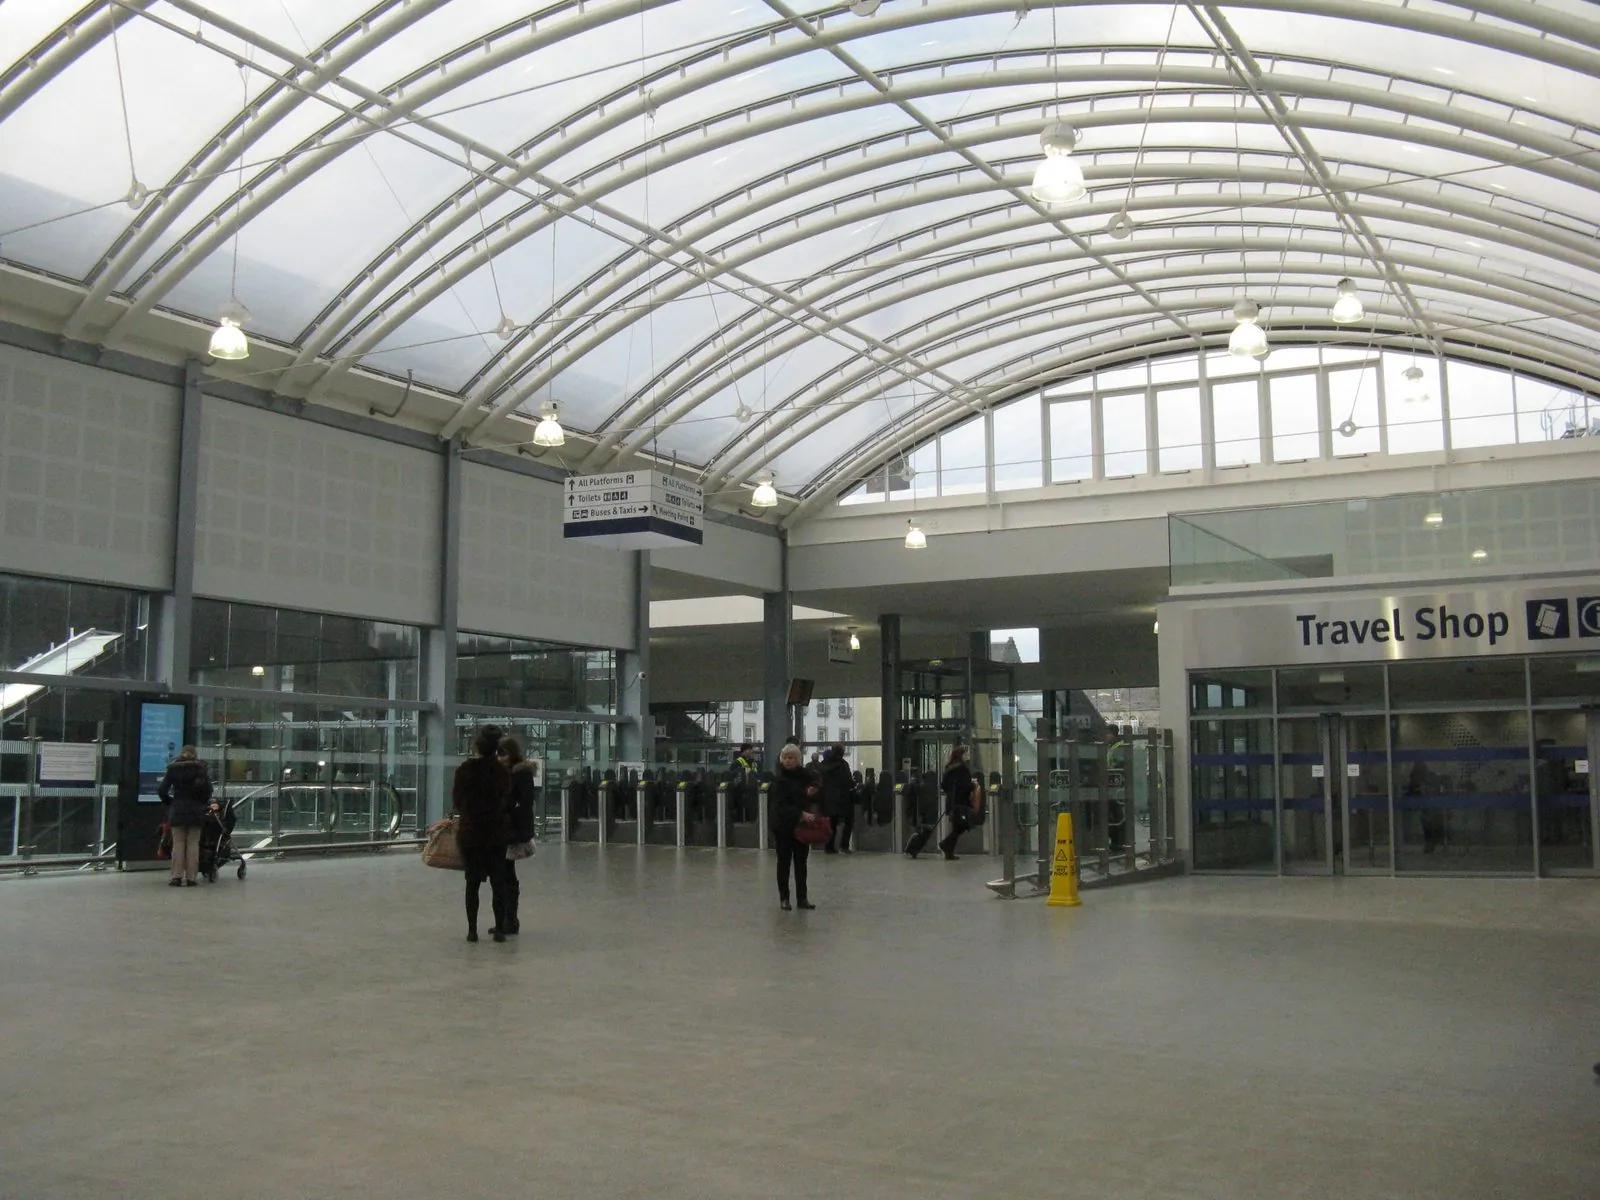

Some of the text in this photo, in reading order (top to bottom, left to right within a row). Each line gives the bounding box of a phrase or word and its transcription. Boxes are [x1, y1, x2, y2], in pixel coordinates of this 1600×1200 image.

[578, 476, 624, 488] All Platforms
[578, 494, 601, 503] Toilets
[590, 505, 637, 517] Buses & Taxis
[1296, 605, 1510, 646] Travel Shop
